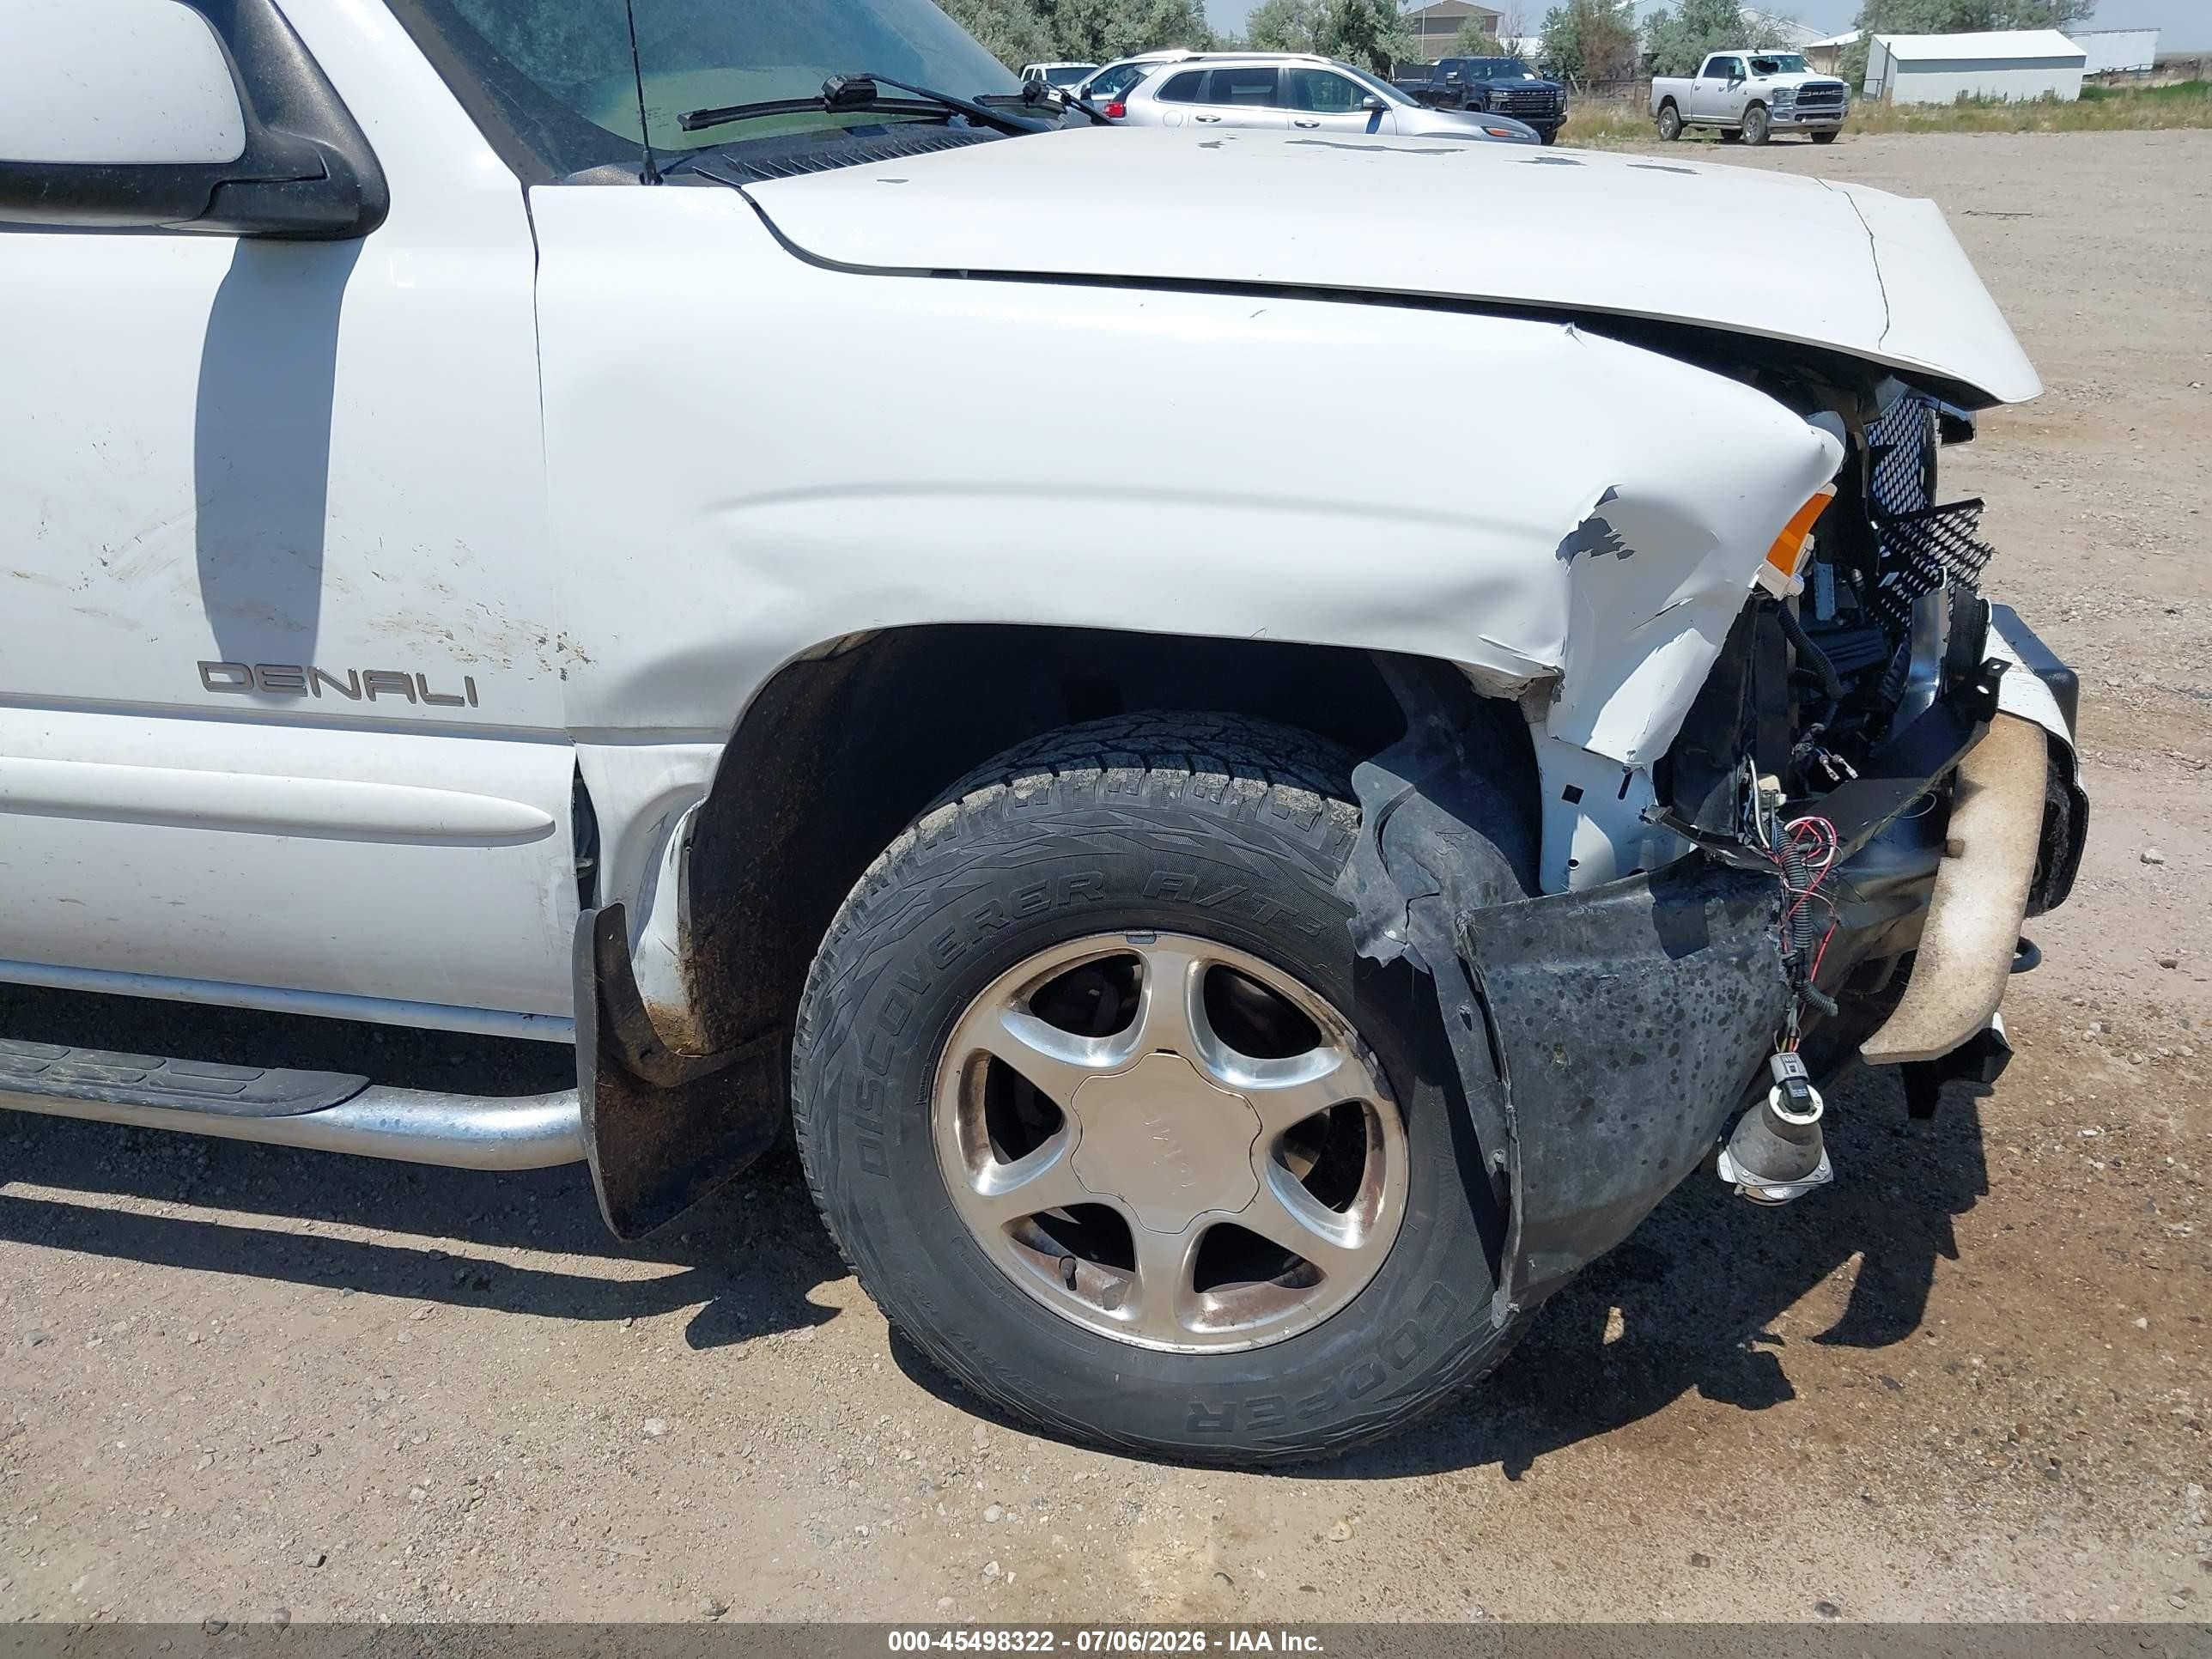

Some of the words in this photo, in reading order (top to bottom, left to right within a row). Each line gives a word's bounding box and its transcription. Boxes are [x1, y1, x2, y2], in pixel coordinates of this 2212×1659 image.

[196, 659, 479, 708] DENALI
[854, 870, 1104, 1179] DISCOVERER
[1186, 1279, 1459, 1433] COOPER
